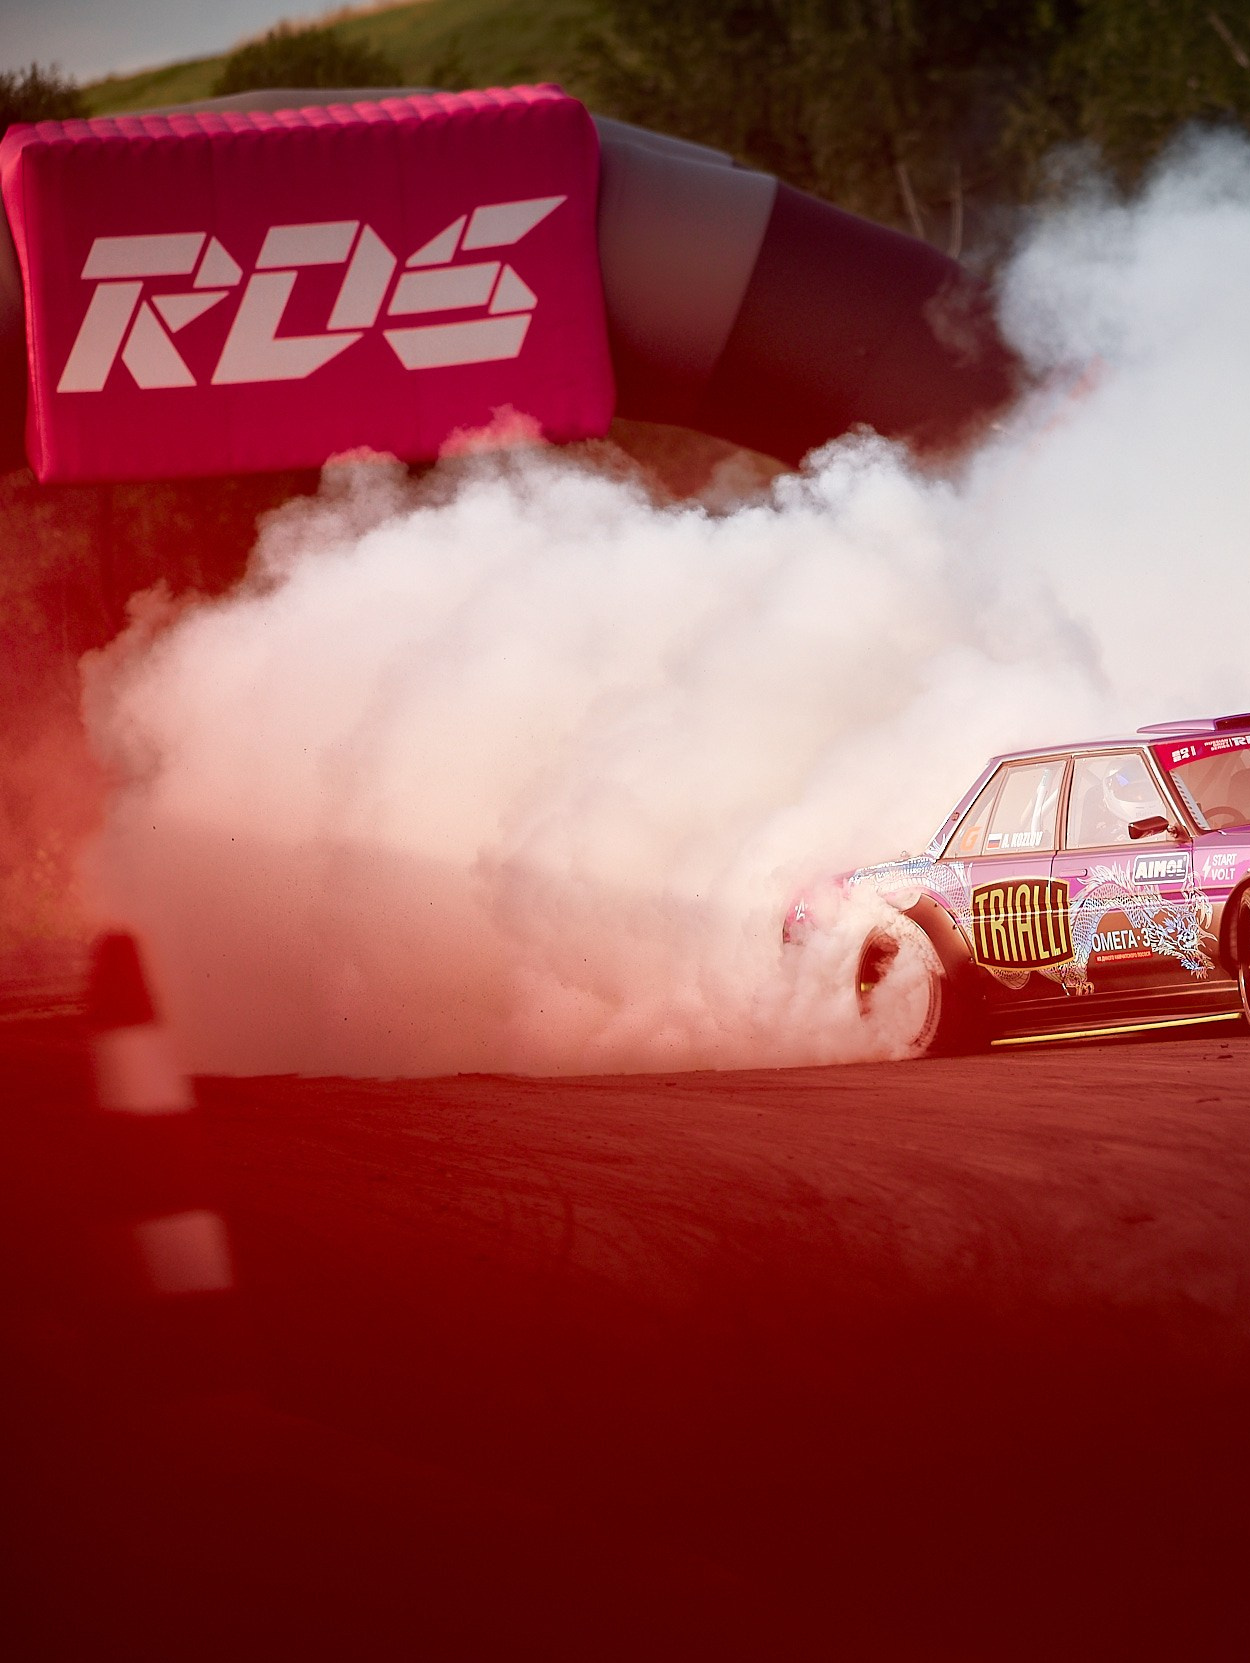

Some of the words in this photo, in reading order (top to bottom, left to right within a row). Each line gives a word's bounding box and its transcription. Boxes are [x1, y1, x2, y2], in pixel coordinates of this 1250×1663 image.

[57, 195, 568, 392] RDS
[1010, 831, 1043, 848] KOZLOV
[1212, 853, 1237, 866] START
[1135, 859, 1185, 879] AIMOL
[1211, 867, 1236, 881] VOLT
[975, 884, 1068, 962] TRIALLI
